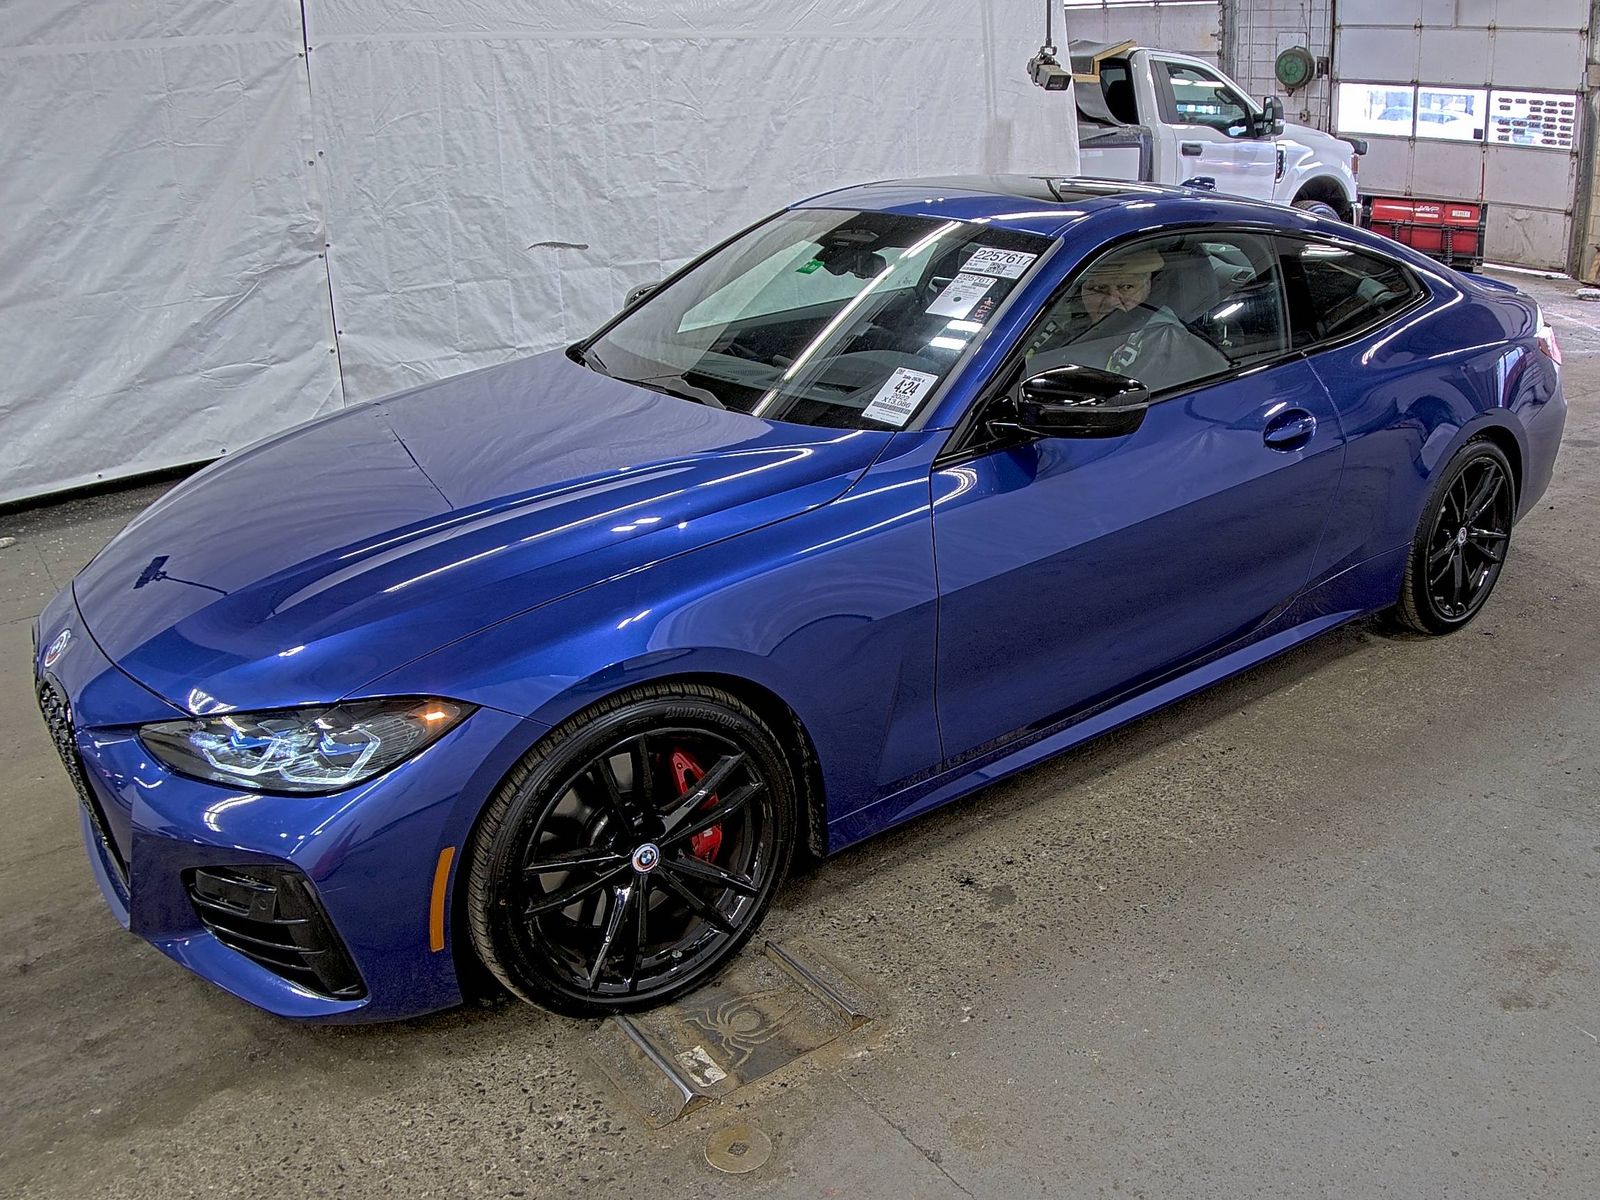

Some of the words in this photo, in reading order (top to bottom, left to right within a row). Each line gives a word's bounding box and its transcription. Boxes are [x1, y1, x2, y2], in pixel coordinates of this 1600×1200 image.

[973, 249, 1035, 266] 2257617
[891, 393, 910, 402] 2022
[664, 706, 742, 730] BRIDGESTONE
